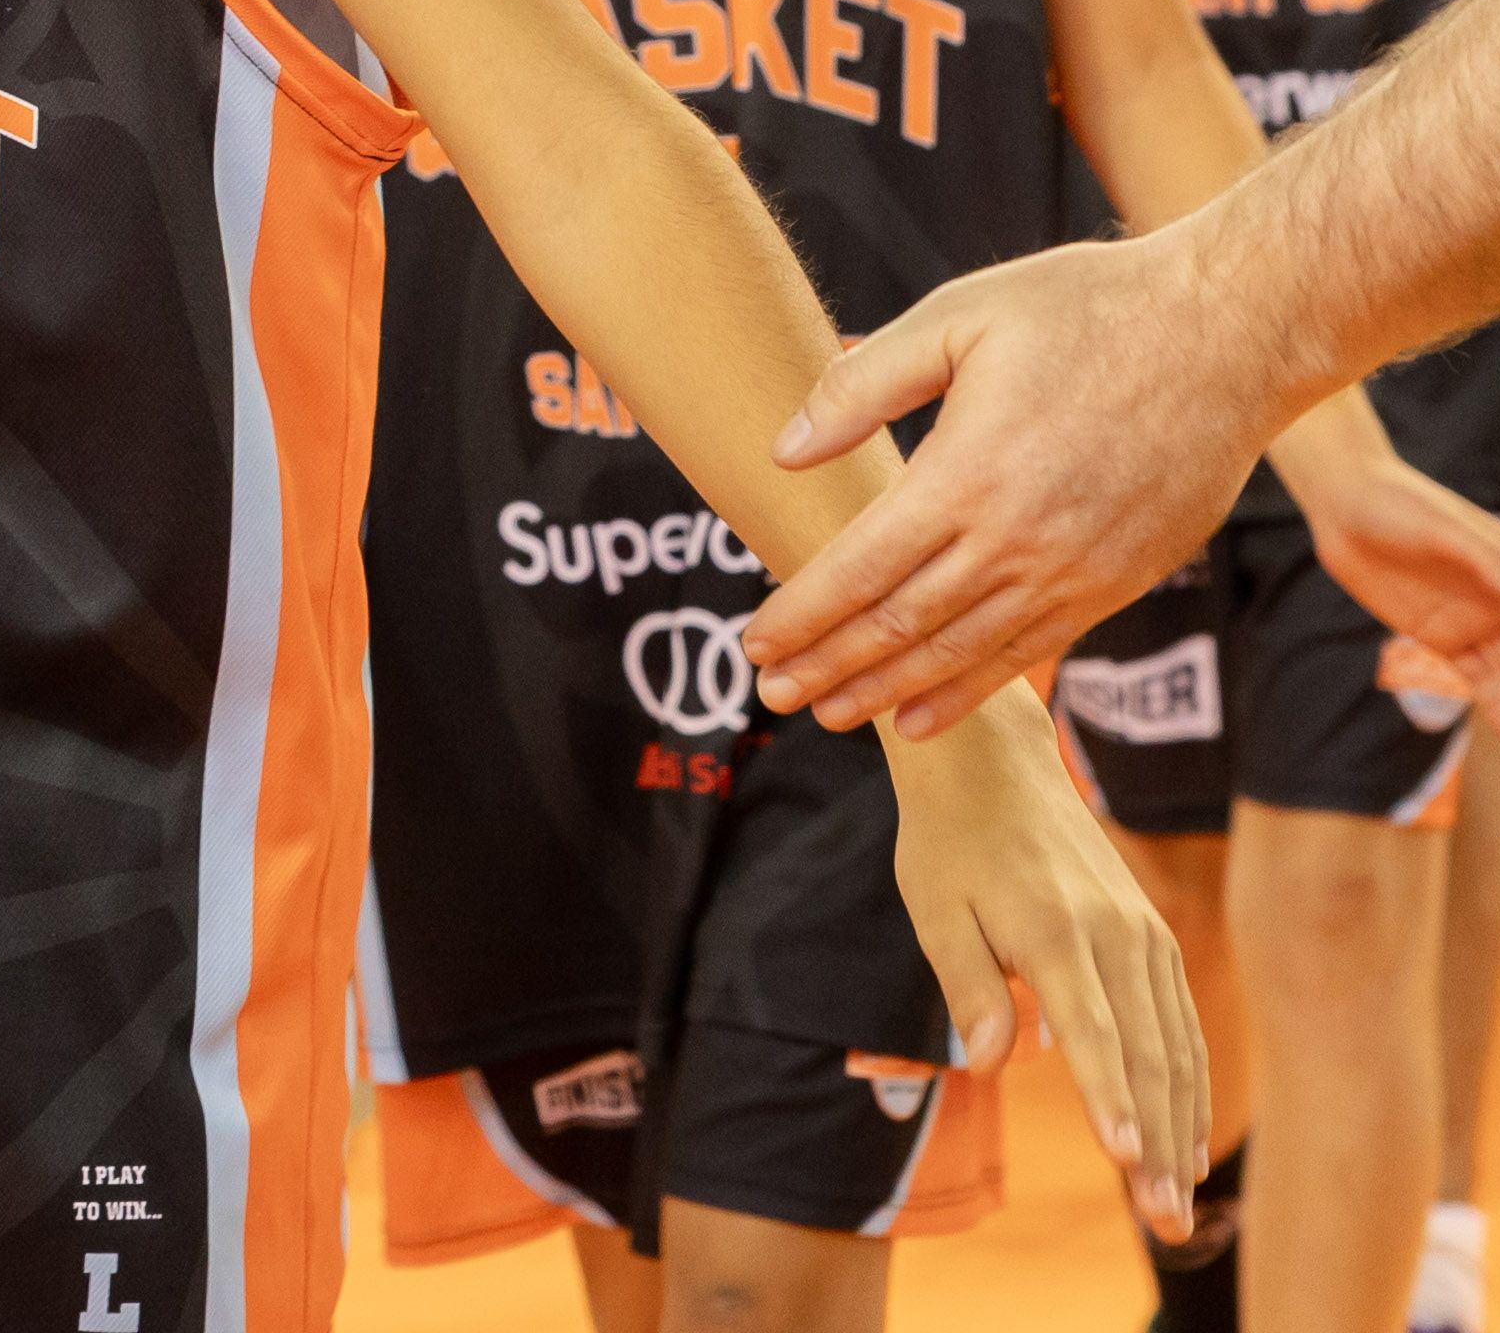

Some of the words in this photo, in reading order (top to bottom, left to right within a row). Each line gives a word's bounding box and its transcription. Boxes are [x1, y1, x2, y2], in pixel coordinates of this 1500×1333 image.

[81, 1165, 91, 1185] I
[94, 1164, 147, 1185] PLAY
[72, 1201, 101, 1221] TO
